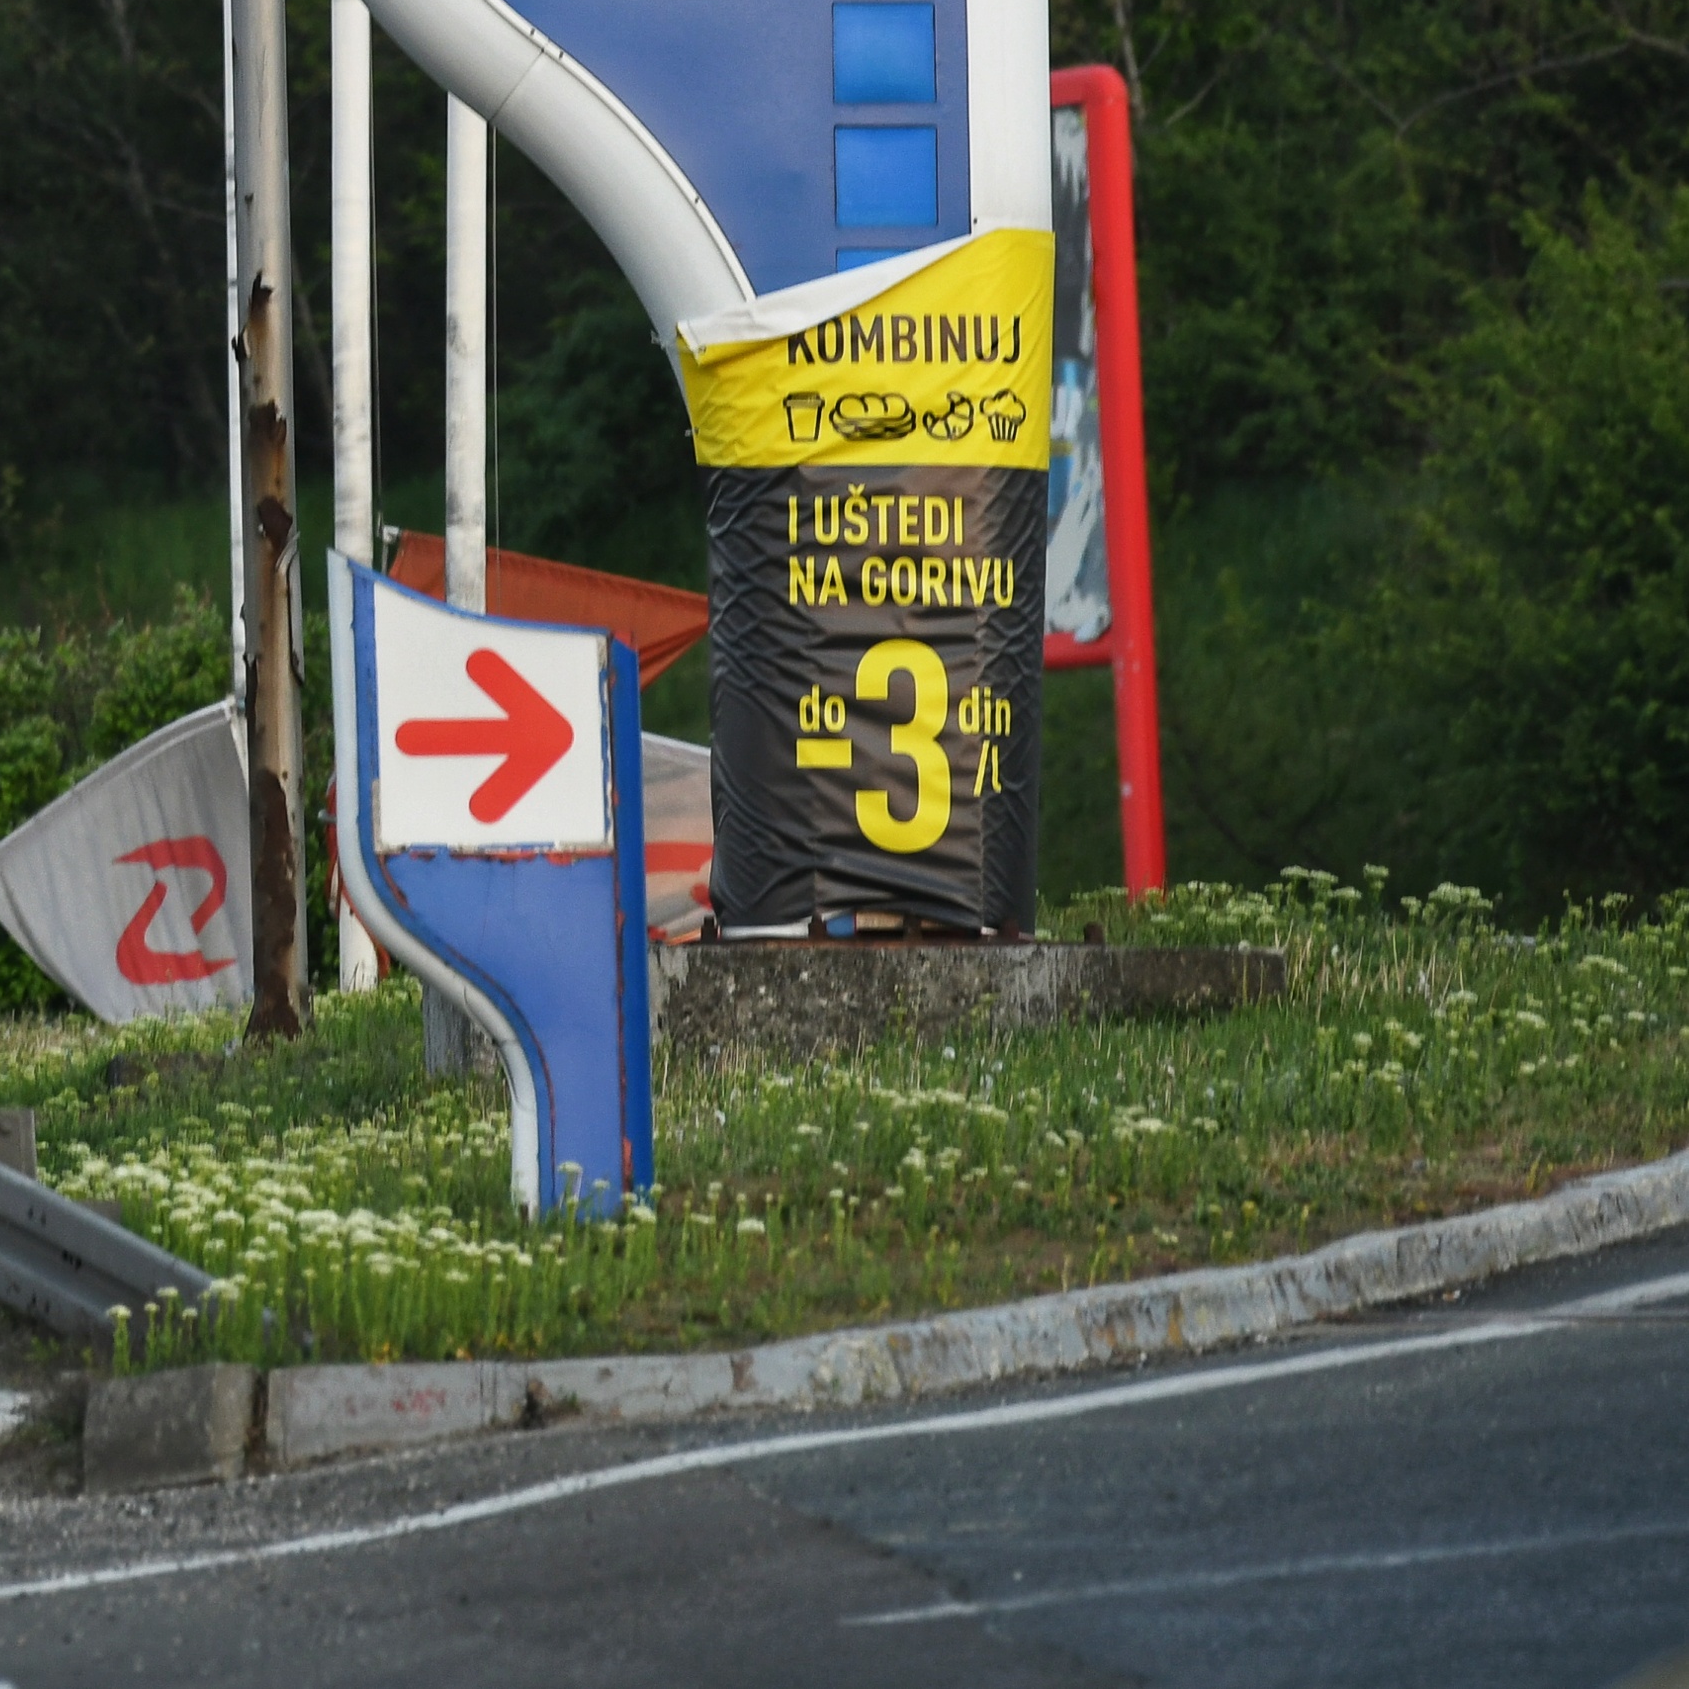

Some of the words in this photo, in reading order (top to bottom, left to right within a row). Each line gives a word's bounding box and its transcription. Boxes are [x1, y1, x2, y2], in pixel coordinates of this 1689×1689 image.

[788, 313, 1020, 364] KOMBINUJ
[788, 495, 798, 545] I
[814, 483, 963, 545] UŠTEDI
[789, 555, 848, 606] NA
[861, 556, 1014, 608] GORIVU
[799, 684, 846, 733] do
[958, 685, 1011, 737] din
